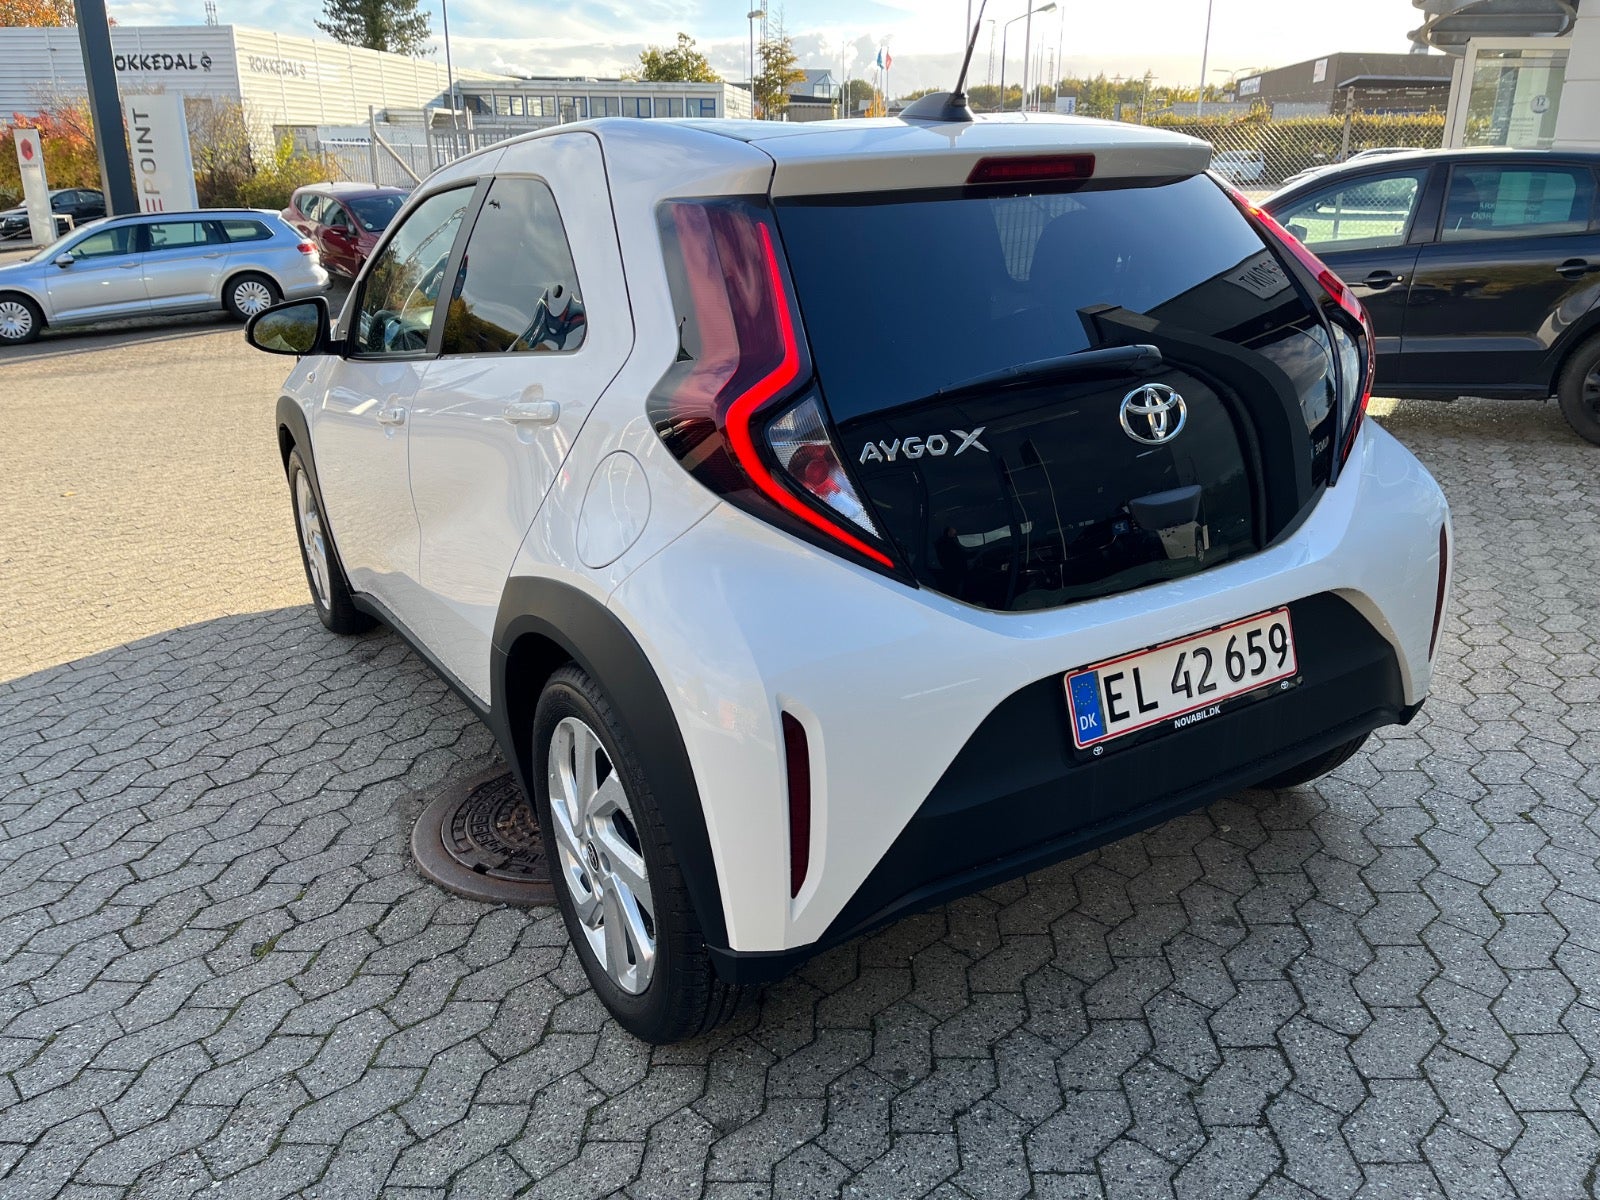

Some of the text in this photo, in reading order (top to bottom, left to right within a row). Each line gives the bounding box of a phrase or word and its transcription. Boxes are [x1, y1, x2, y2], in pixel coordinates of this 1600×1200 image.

[114, 54, 198, 71] OKKEDAL
[249, 55, 298, 76] ROKKEDAL
[859, 426, 990, 465] AYGO X
[1103, 622, 1288, 723] EL 42 659
[1079, 712, 1098, 731] DK
[1174, 705, 1221, 729] NOVABIL.DK
